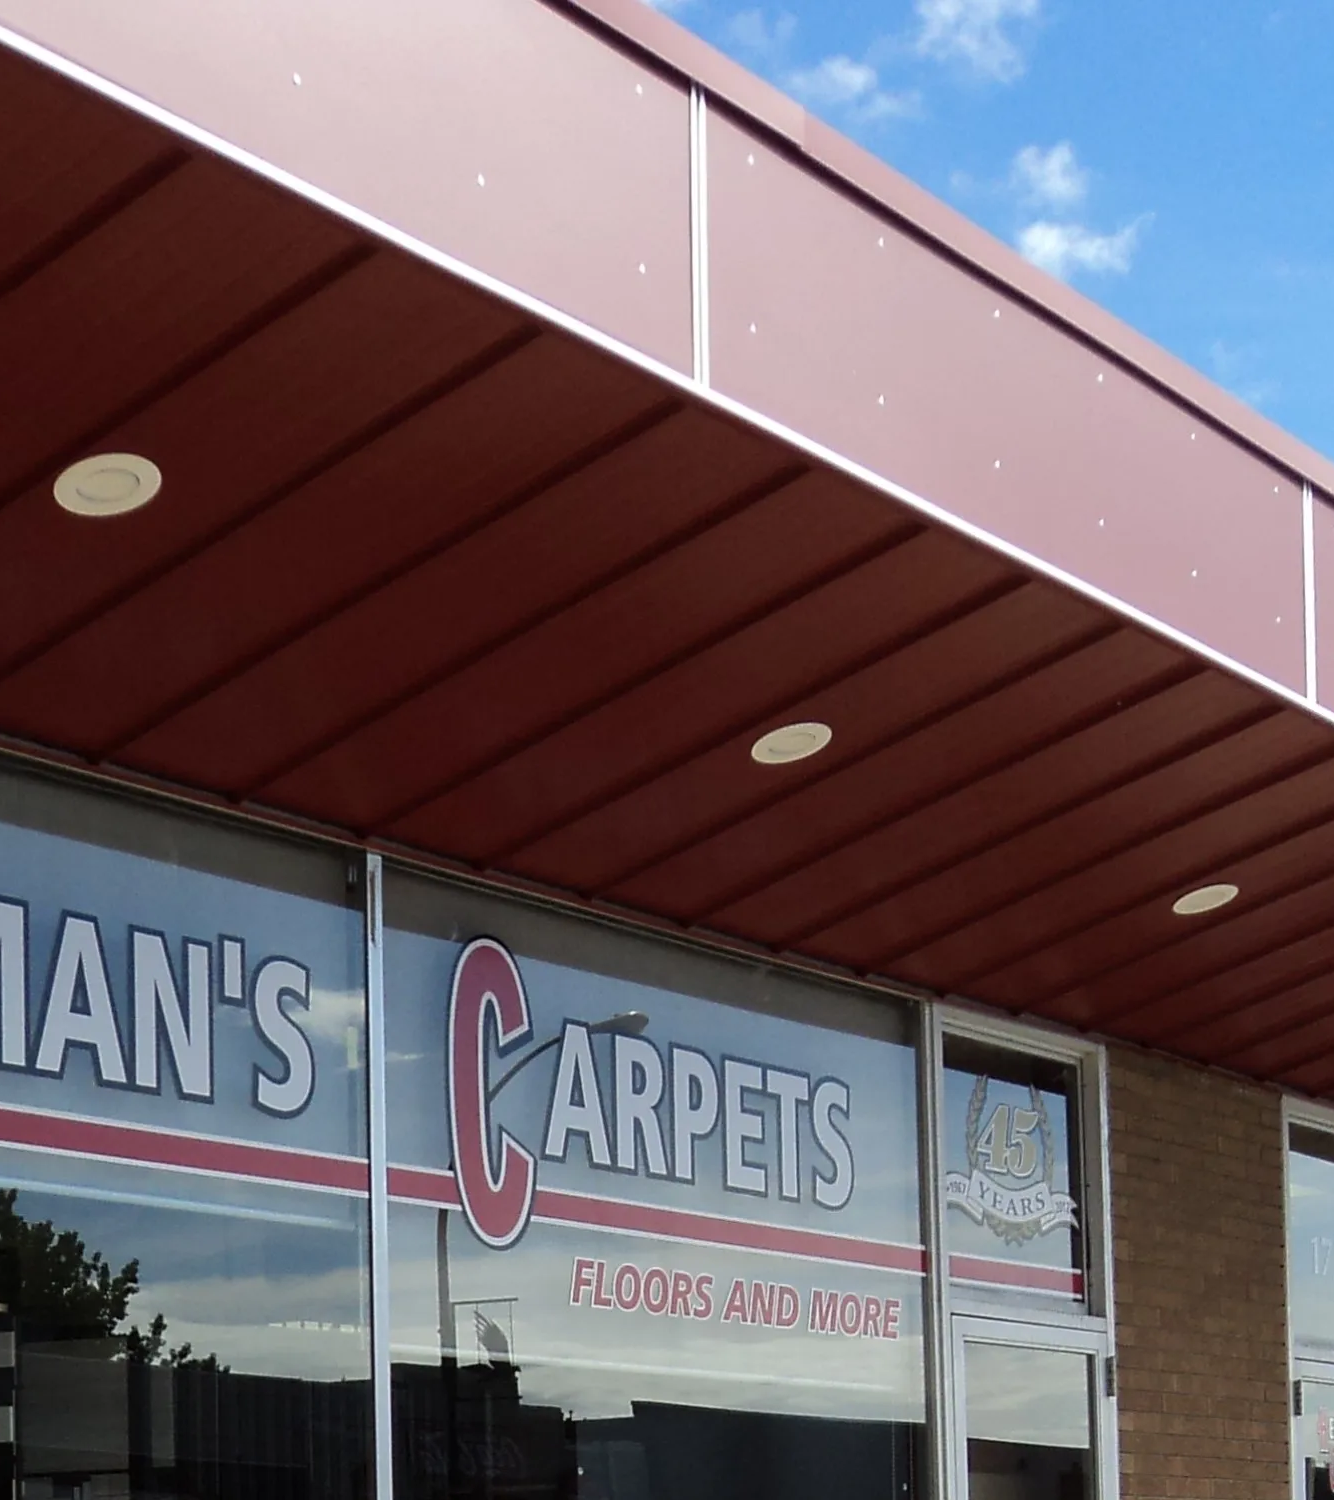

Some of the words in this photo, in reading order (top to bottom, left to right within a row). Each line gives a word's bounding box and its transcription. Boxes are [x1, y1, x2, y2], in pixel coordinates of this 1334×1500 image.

[448, 936, 855, 1250] CARPETS
[977, 1103, 1039, 1178] 45
[978, 1181, 1046, 1217] YEARS
[570, 1257, 715, 1320] FLOORS
[721, 1278, 801, 1329] AND
[807, 1288, 902, 1342] MORE
